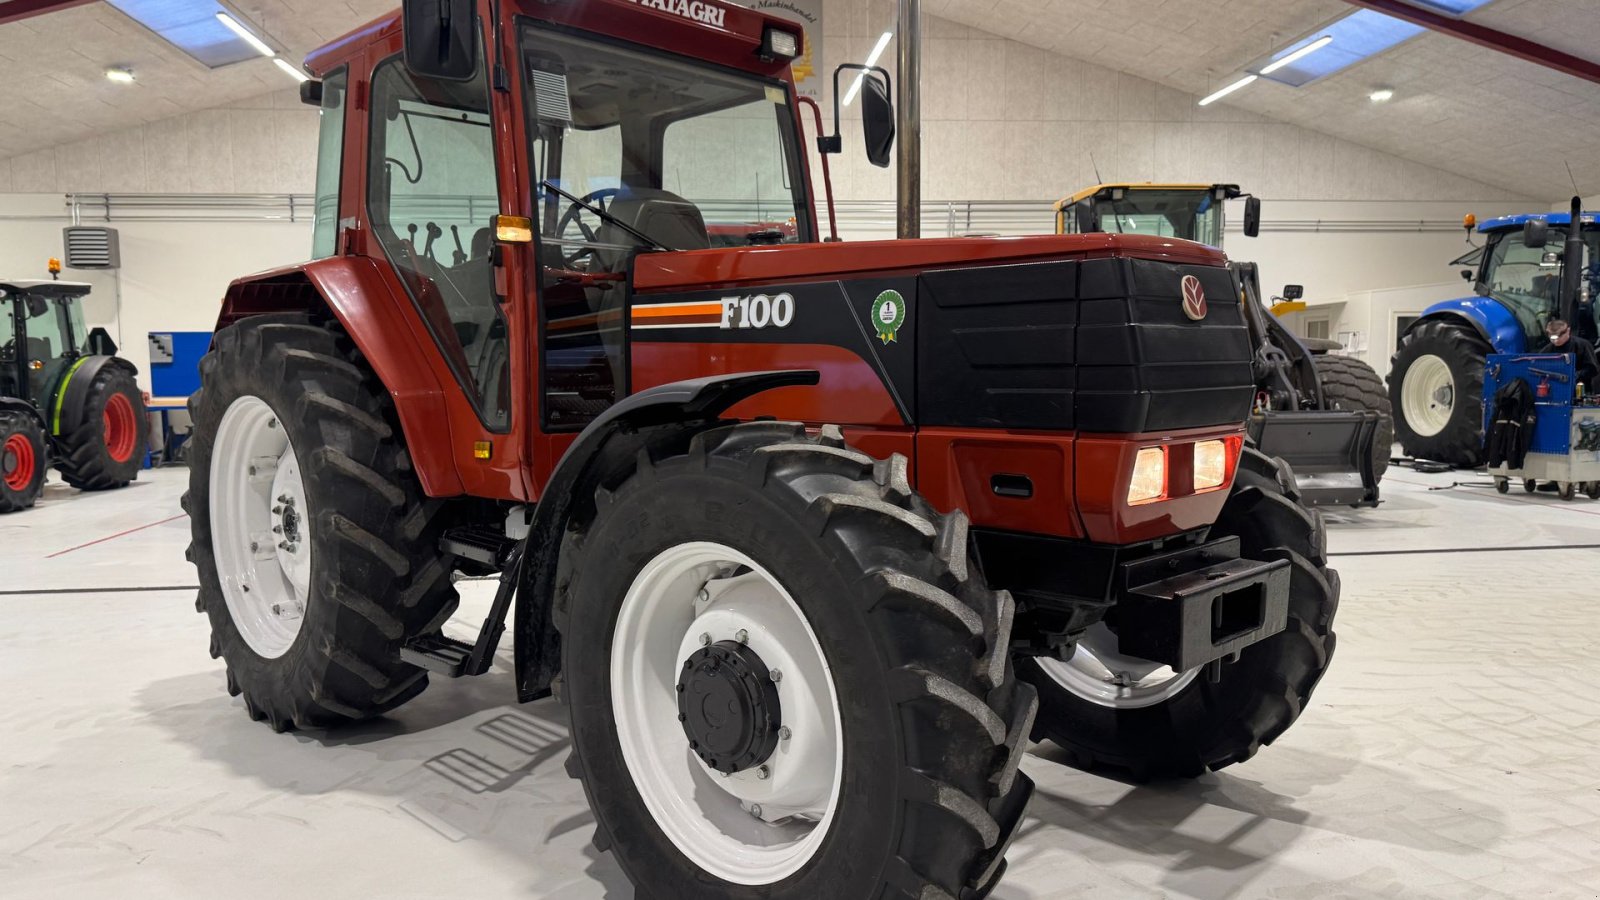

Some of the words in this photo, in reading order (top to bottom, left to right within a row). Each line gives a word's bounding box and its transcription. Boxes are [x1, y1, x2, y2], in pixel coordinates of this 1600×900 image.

[627, 0, 726, 27] ATAGRI
[720, 293, 795, 329] F100
[885, 302, 891, 311] 1
